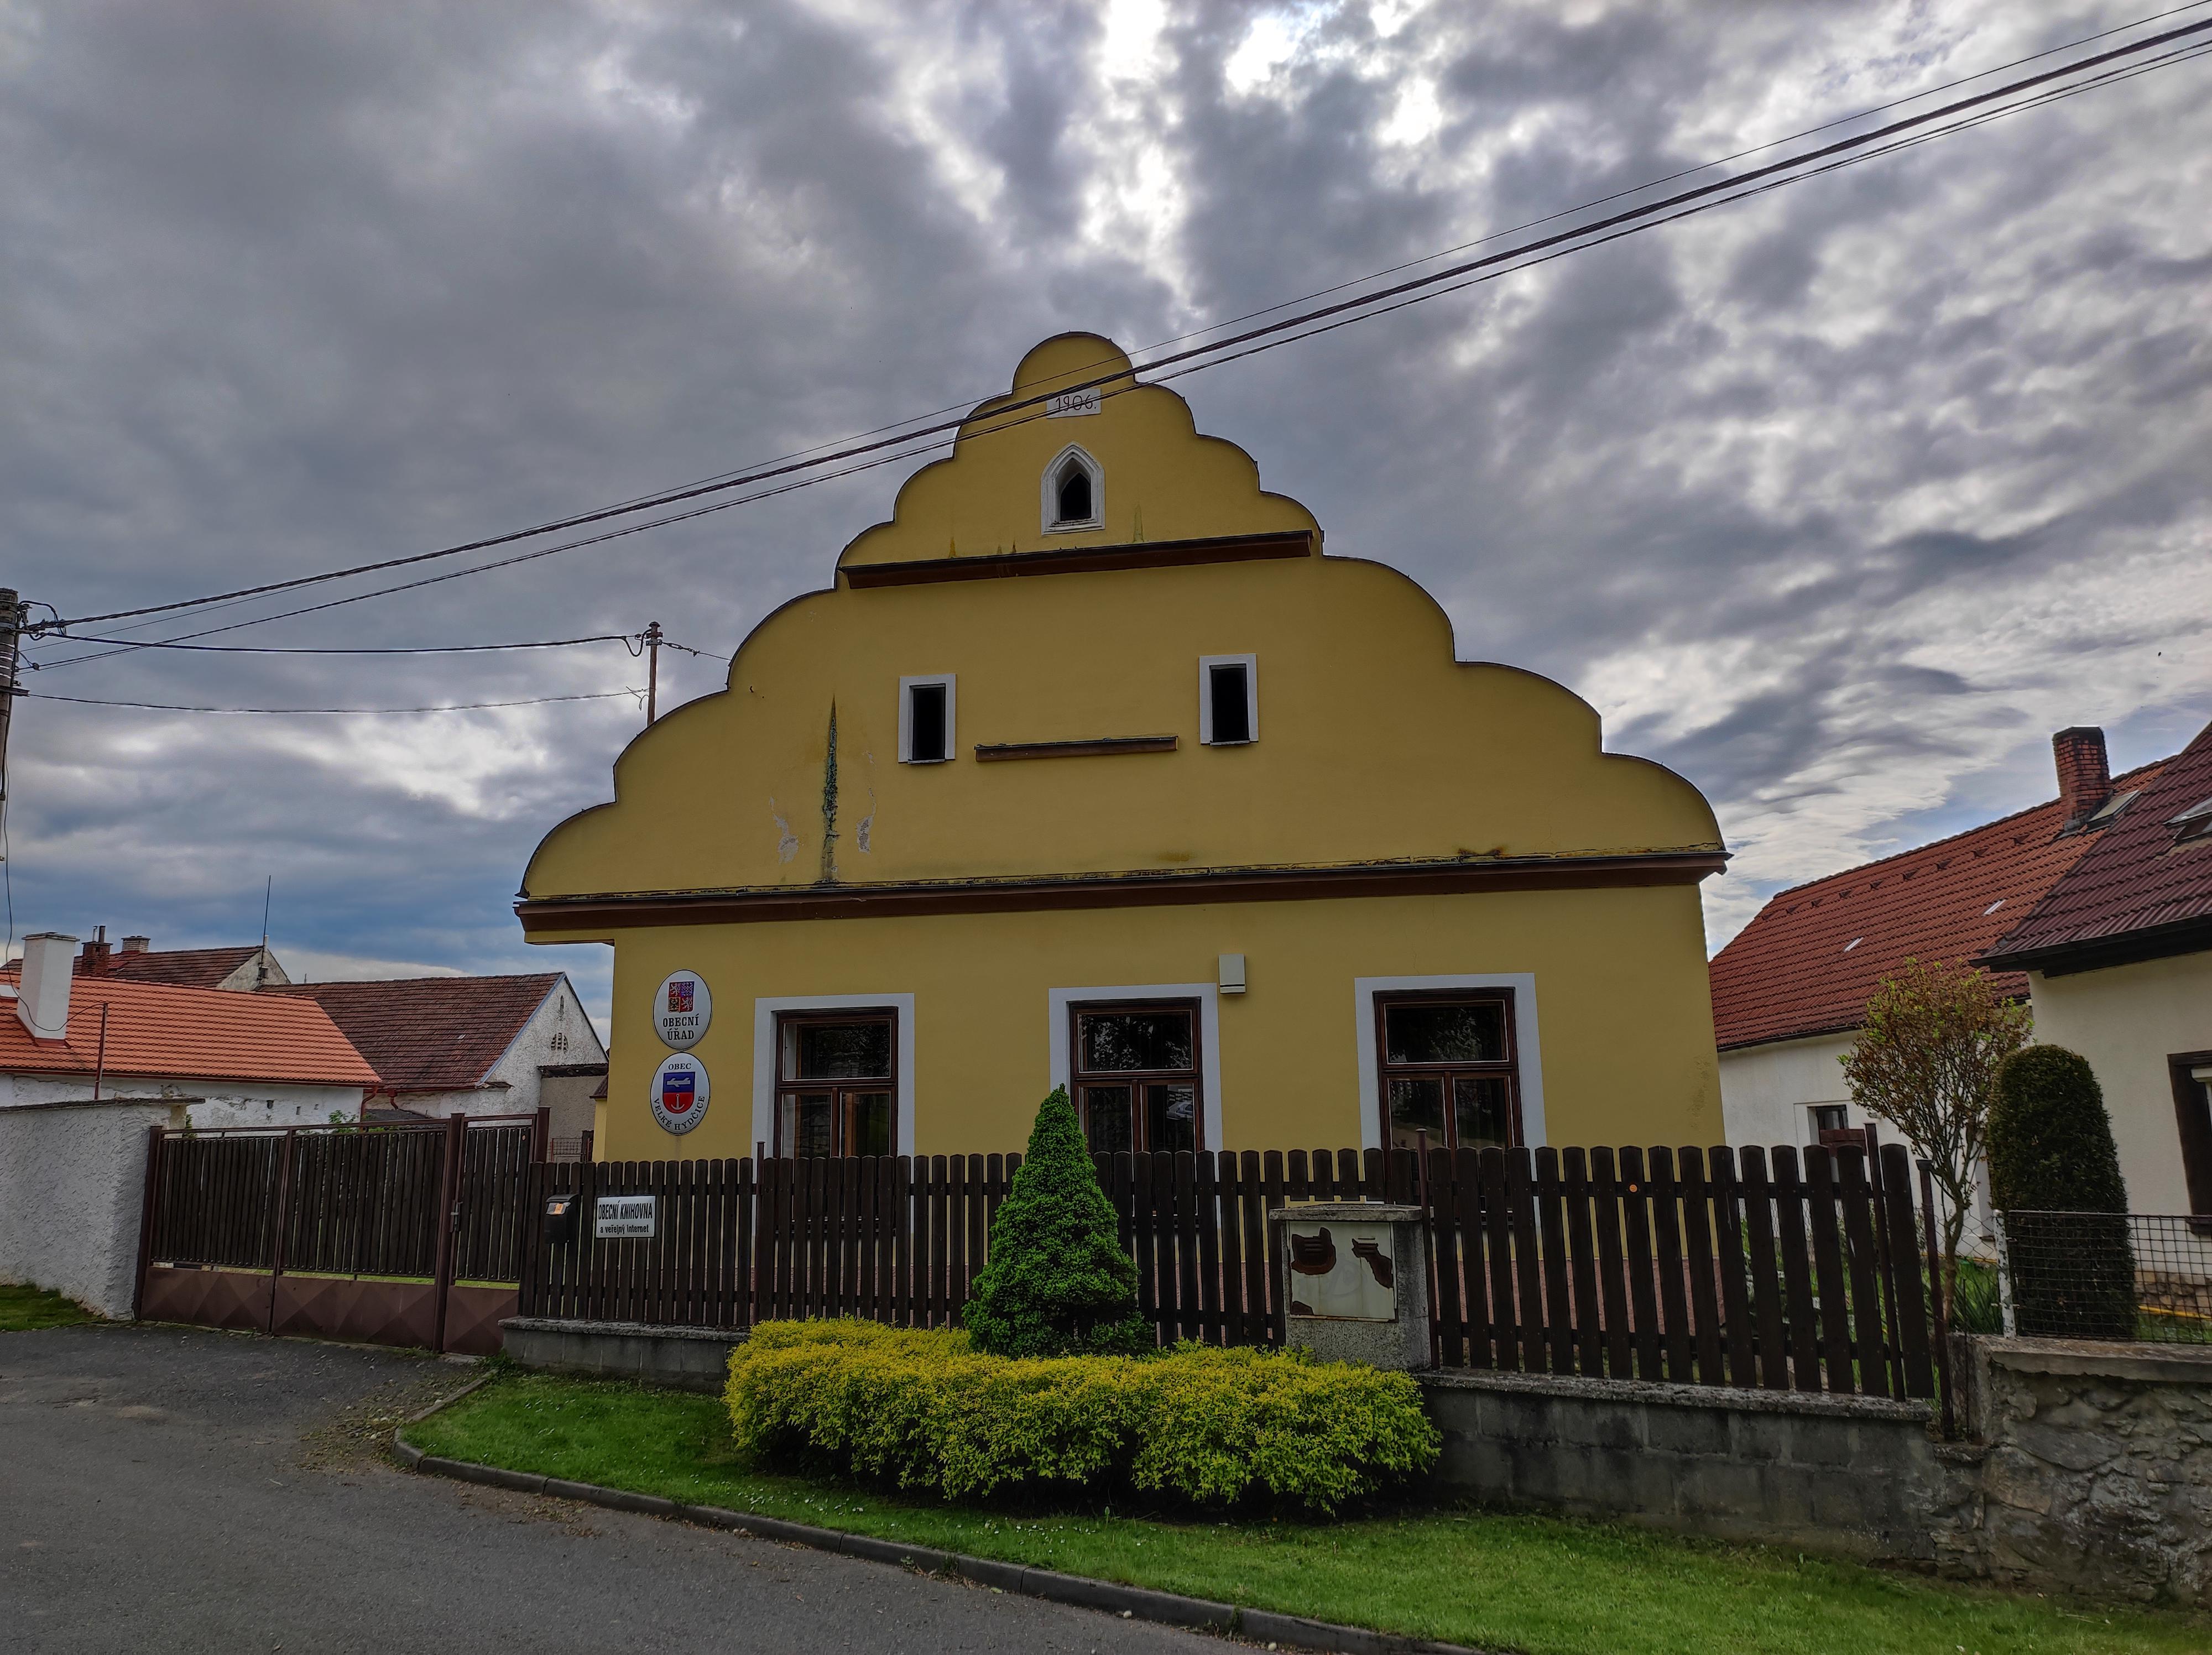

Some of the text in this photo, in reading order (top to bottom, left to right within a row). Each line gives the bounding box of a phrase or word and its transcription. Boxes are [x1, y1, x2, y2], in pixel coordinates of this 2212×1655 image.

[663, 1013, 700, 1027] OBECNÍ
[667, 1027, 694, 1040] ÚŘAD
[654, 1096, 705, 1130] VELKÉ HYDČICE
[598, 1200, 653, 1220] OBECNÍ KNIHOVNA
[605, 1224, 625, 1235] veřejný
[627, 1224, 649, 1233] internet
